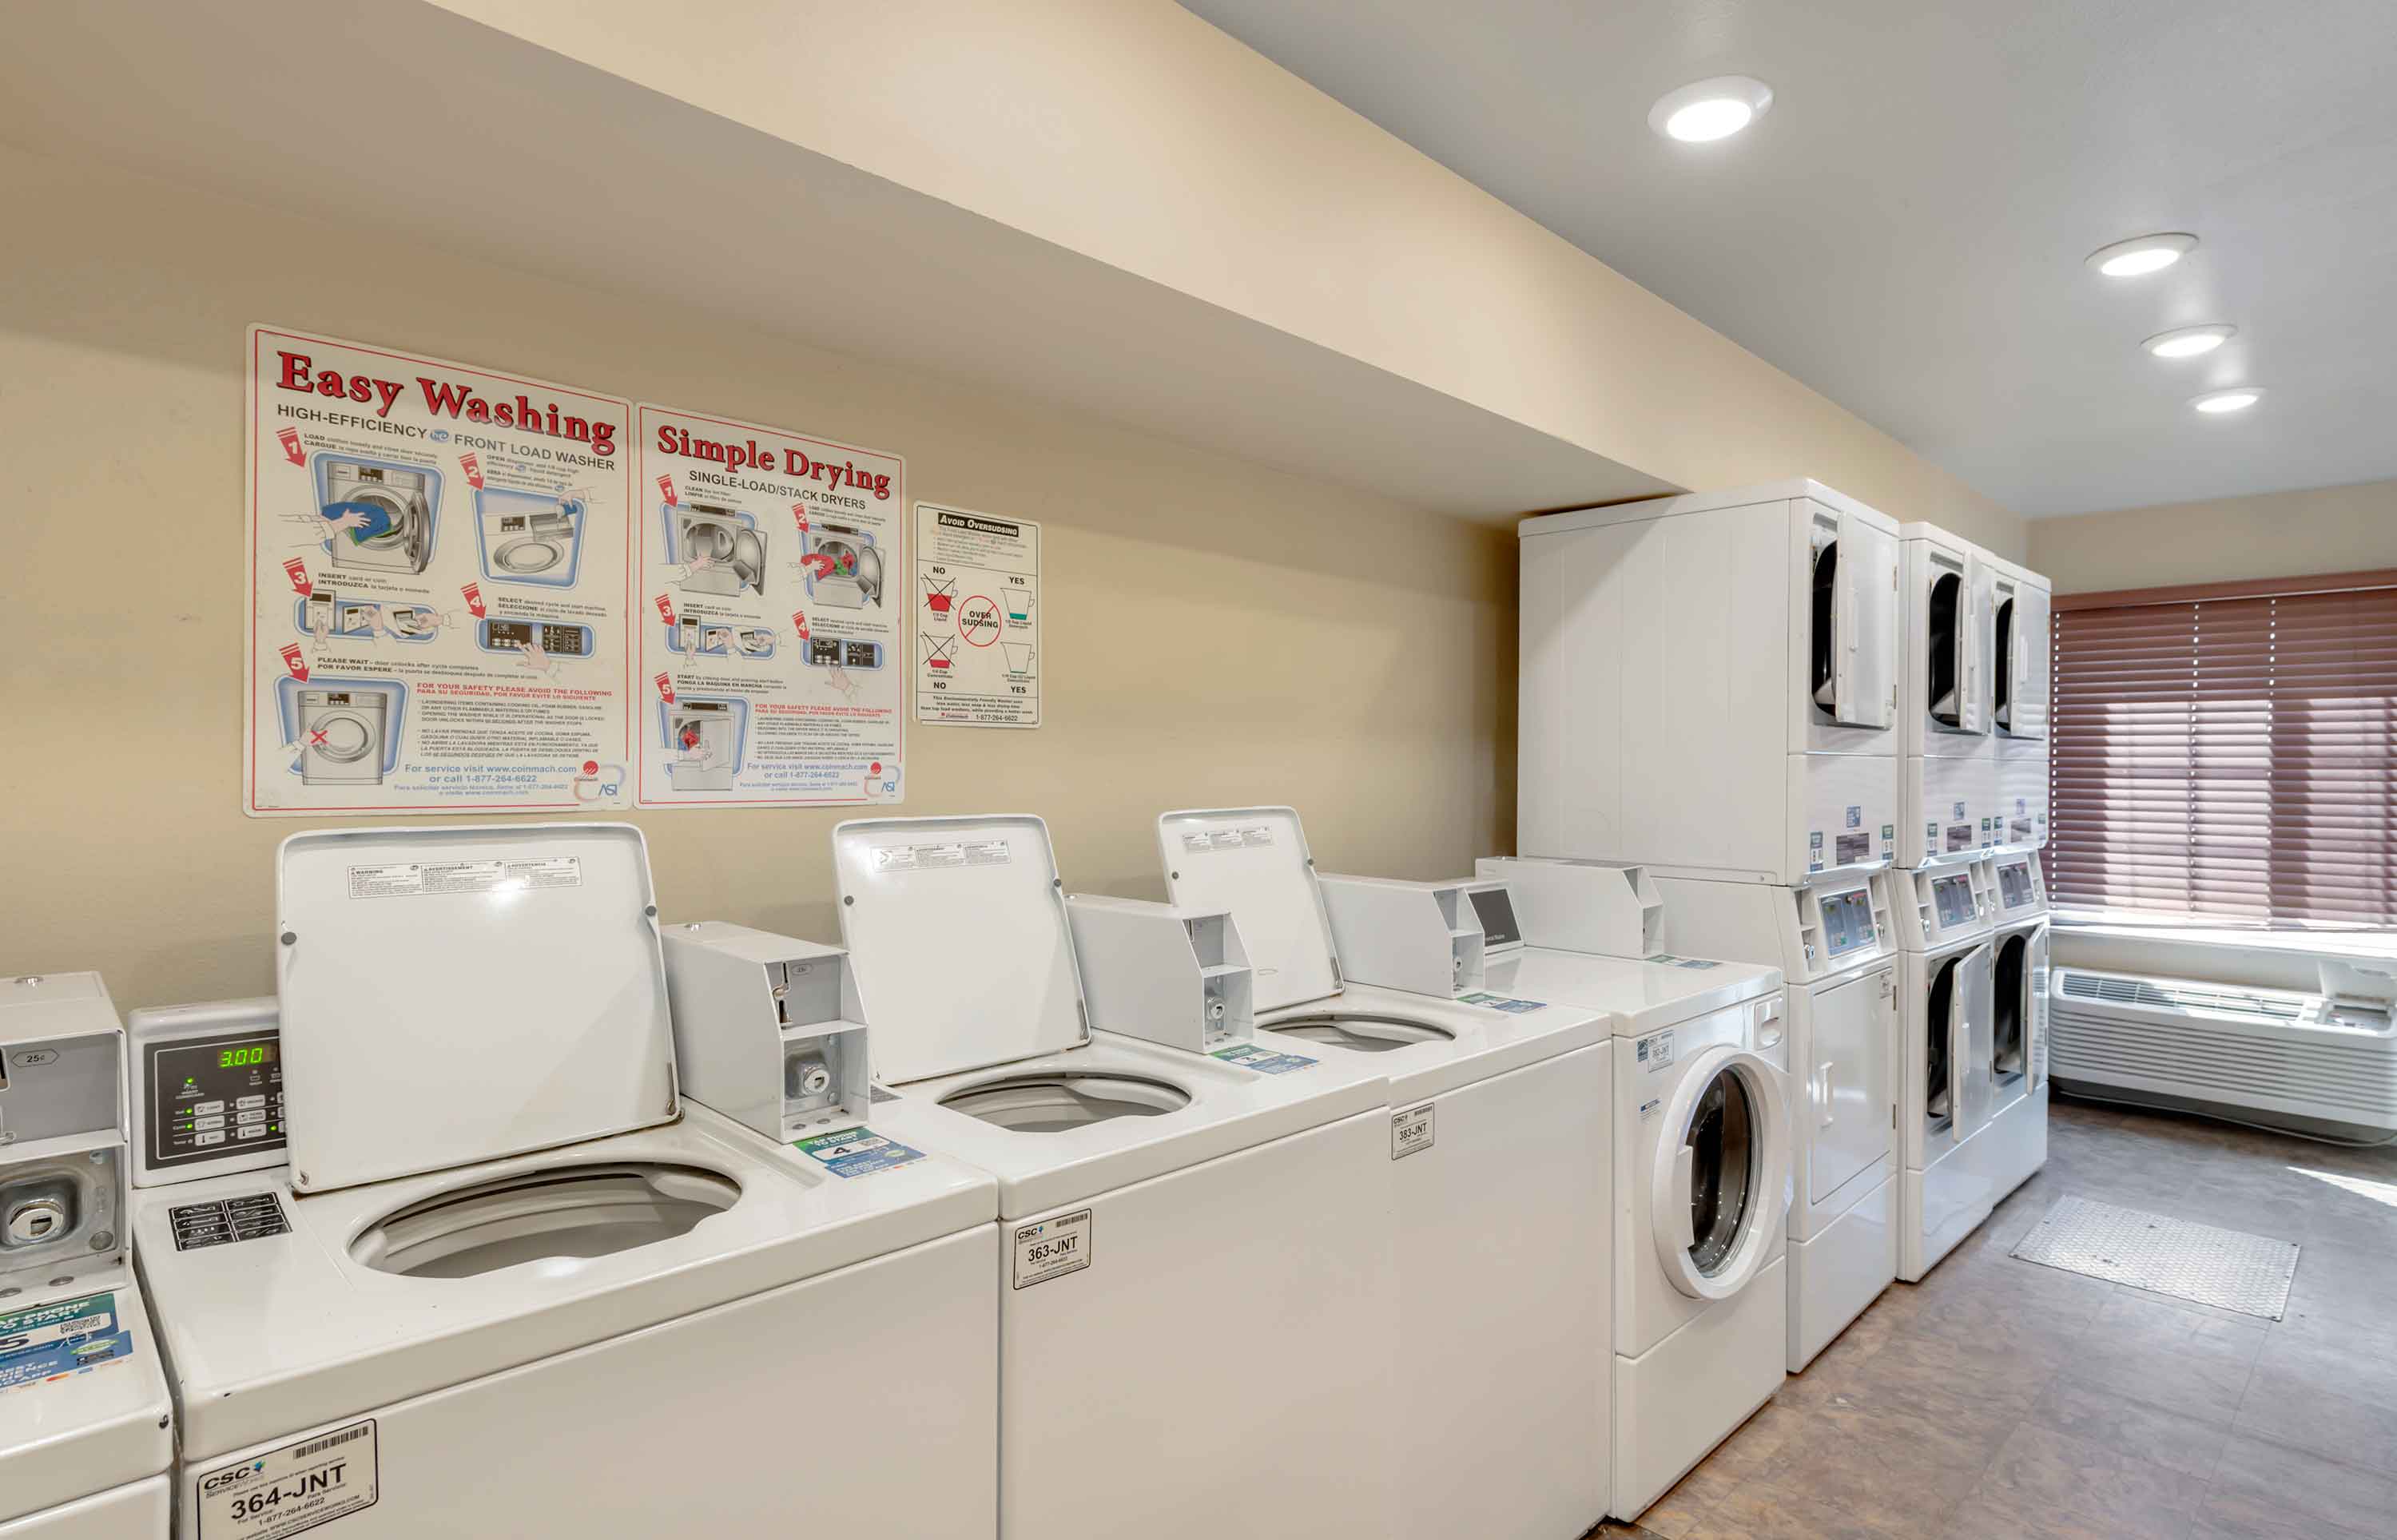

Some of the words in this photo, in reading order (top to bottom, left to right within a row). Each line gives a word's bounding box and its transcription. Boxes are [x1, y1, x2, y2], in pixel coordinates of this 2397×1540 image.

[276, 351, 403, 418] Easy
[416, 376, 616, 456] Washing
[277, 403, 427, 441] HIGH-EFFICIENCY
[454, 434, 506, 453] FRONT
[511, 443, 551, 460] LOAD
[555, 450, 615, 471] WASHER
[288, 440, 298, 454] 1
[304, 440, 336, 450] CARGUE
[658, 425, 775, 474] Simple
[783, 448, 890, 500] Drying
[467, 466, 479, 478] 2
[689, 470, 818, 502] SINGLE-LOAD/STACK
[821, 493, 866, 510] DRYERS
[940, 514, 965, 527] AVOID
[967, 519, 1018, 536] OVERSUDSING
[318, 572, 346, 581] INSERT
[932, 566, 946, 575] NO
[292, 571, 306, 585] 3
[318, 579, 369, 589] INTRODUZCA
[1009, 576, 1025, 585] YES
[498, 603, 539, 612] SELECCIONE
[662, 605, 672, 617] 3
[968, 610, 992, 620] OVER
[961, 618, 999, 629] SUDSING
[289, 657, 303, 670] 5
[662, 684, 672, 695] 5
[405, 764, 422, 772] For
[425, 764, 461, 773] service
[463, 764, 483, 773] visit
[486, 764, 577, 773] www.coinmach.com
[26, 1054, 46, 1064] 25¢
[219, 1047, 264, 1068] 3.00
[1018, 1228, 1038, 1240] CSC
[1028, 1235, 1078, 1262] 363-JNT
[204, 1467, 250, 1490] CSC
[230, 1463, 348, 1520] 364-JNT
[259, 1497, 326, 1526] 1-877-264-6622
